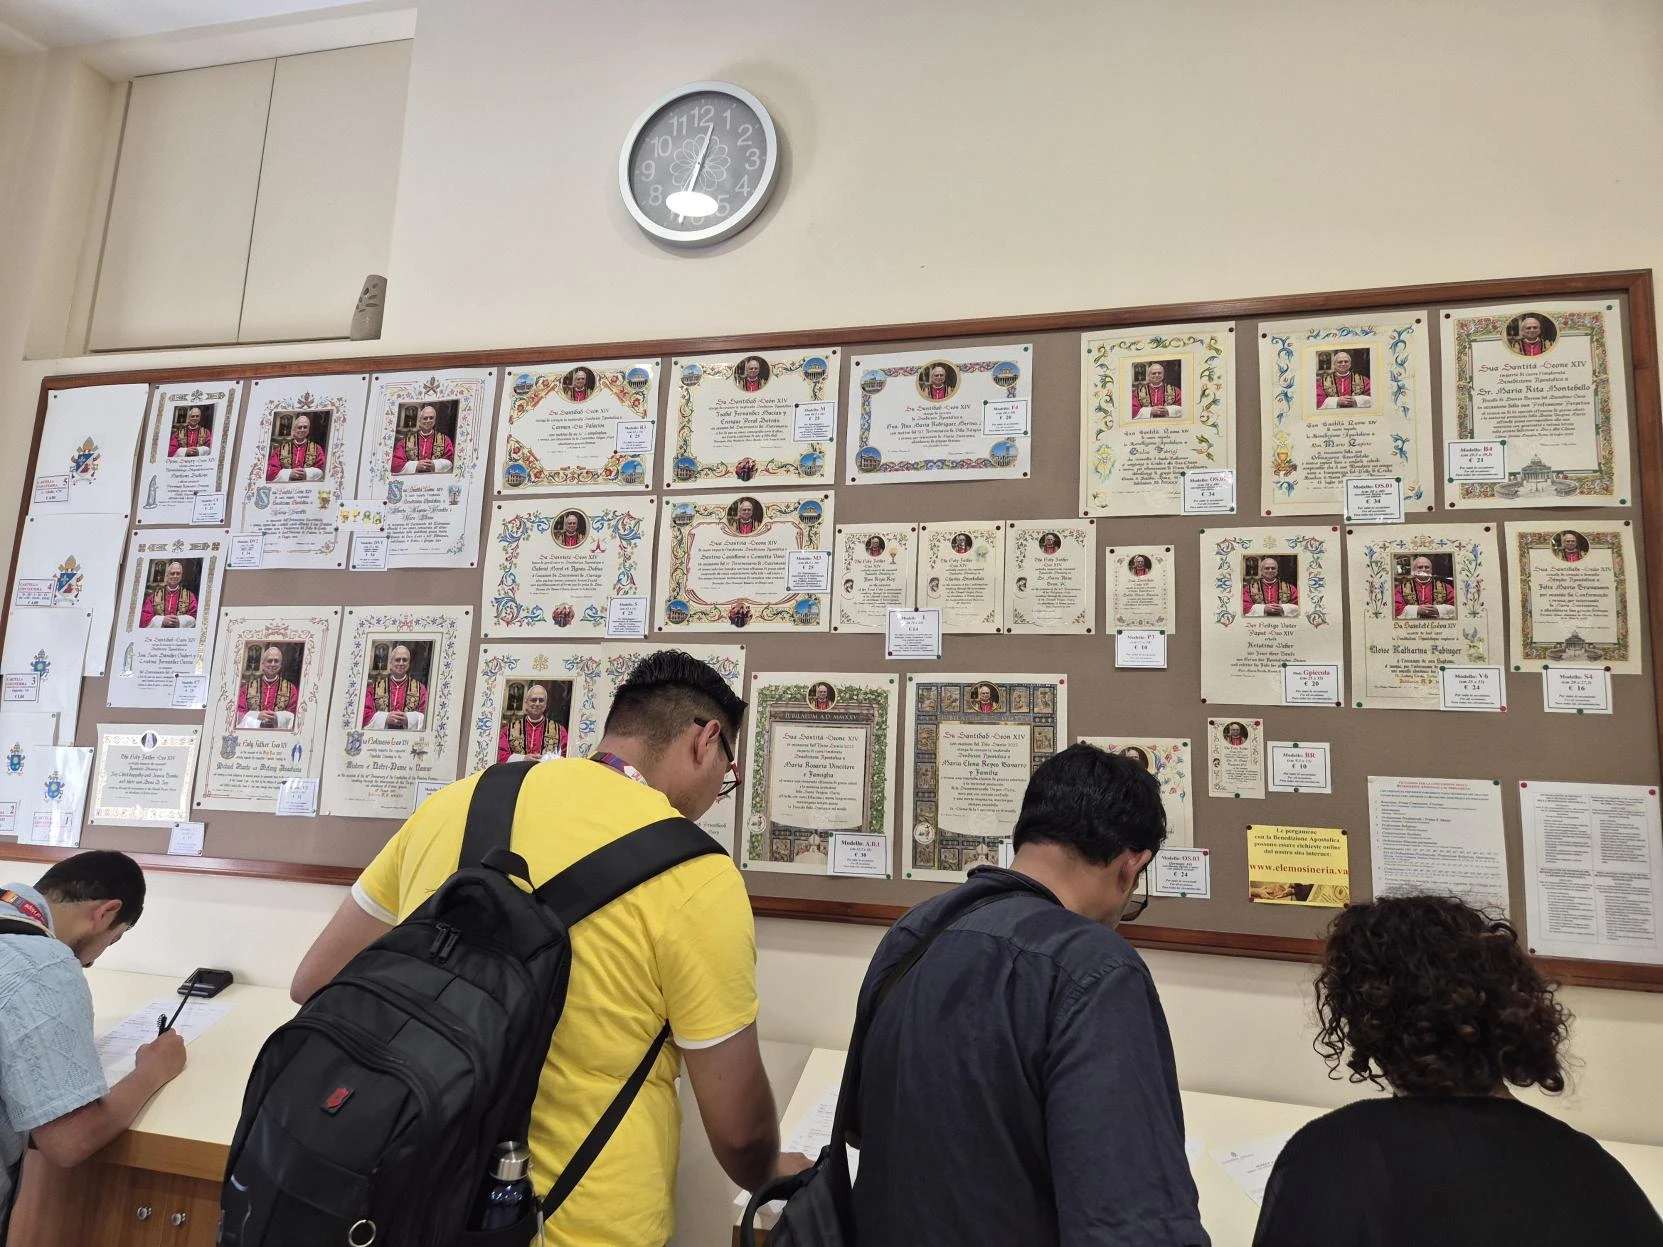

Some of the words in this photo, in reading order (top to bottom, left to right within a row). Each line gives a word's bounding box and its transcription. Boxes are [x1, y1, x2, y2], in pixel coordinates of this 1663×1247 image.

[670, 115, 688, 136] 11
[692, 105, 714, 128] 12
[723, 109, 731, 131] 1
[737, 124, 753, 146] 2
[651, 136, 673, 158] 10
[745, 149, 760, 170] 3
[641, 161, 656, 182] 9
[650, 184, 664, 206] 8
[735, 174, 751, 197] 4
[716, 195, 730, 217] 5
[1249, 863, 1348, 875] www.elemosineria.va
